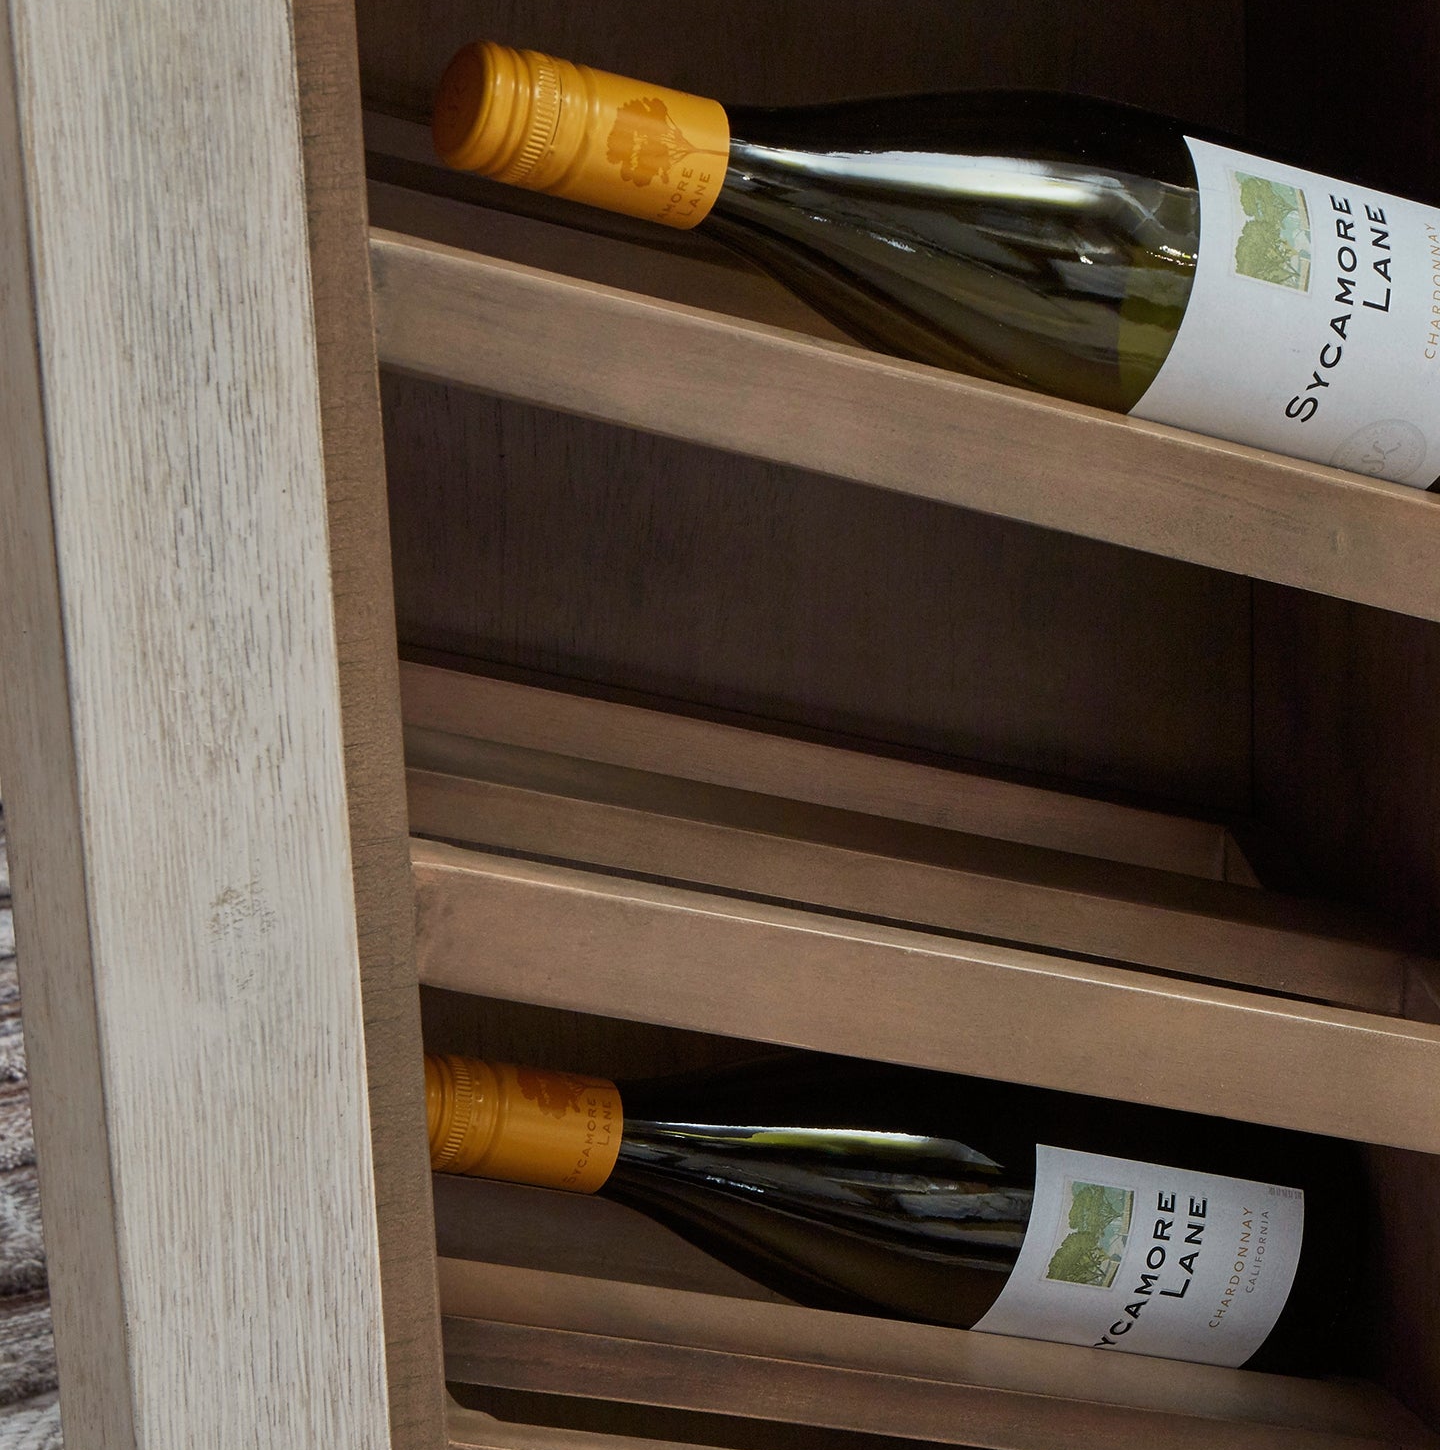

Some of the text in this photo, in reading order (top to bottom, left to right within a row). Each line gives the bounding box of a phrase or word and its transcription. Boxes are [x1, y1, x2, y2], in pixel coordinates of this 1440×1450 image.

[656, 167, 694, 219] AMORE
[679, 173, 711, 217] LANE
[1363, 203, 1392, 313] LANE
[1285, 194, 1358, 423] SYCAMORE
[563, 1097, 597, 1184] SYCAMORE
[597, 1100, 613, 1146] LANE
[1094, 1191, 1176, 1347] YCAMORE
[1160, 1196, 1208, 1299] LANE
[1208, 1206, 1254, 1328] CHARDONNAY
[1245, 1210, 1270, 1294] CALIFORNIA
